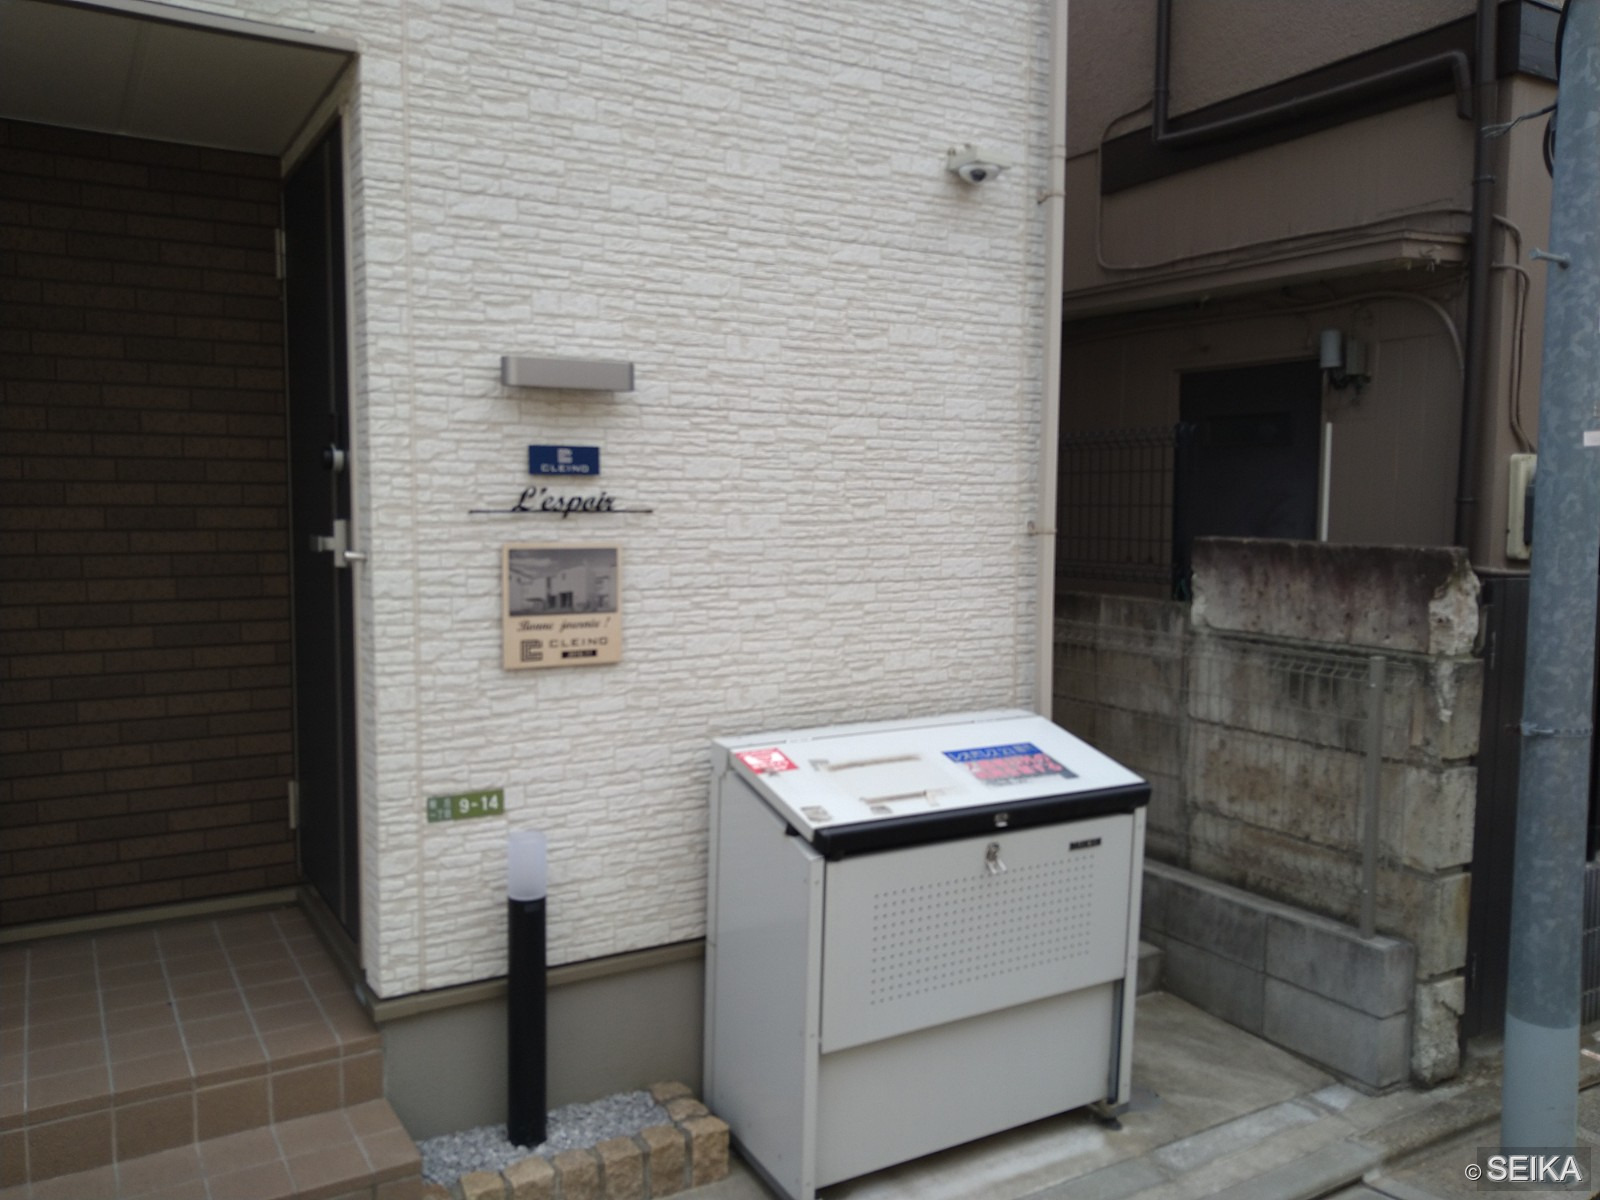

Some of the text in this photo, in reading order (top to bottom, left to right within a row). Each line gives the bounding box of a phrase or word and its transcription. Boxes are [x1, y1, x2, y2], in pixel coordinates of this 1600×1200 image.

[540, 463, 590, 473] CLEINO
[511, 486, 616, 519] L'espoir
[548, 636, 608, 649] CLEINO
[458, 794, 499, 814] 9-14
